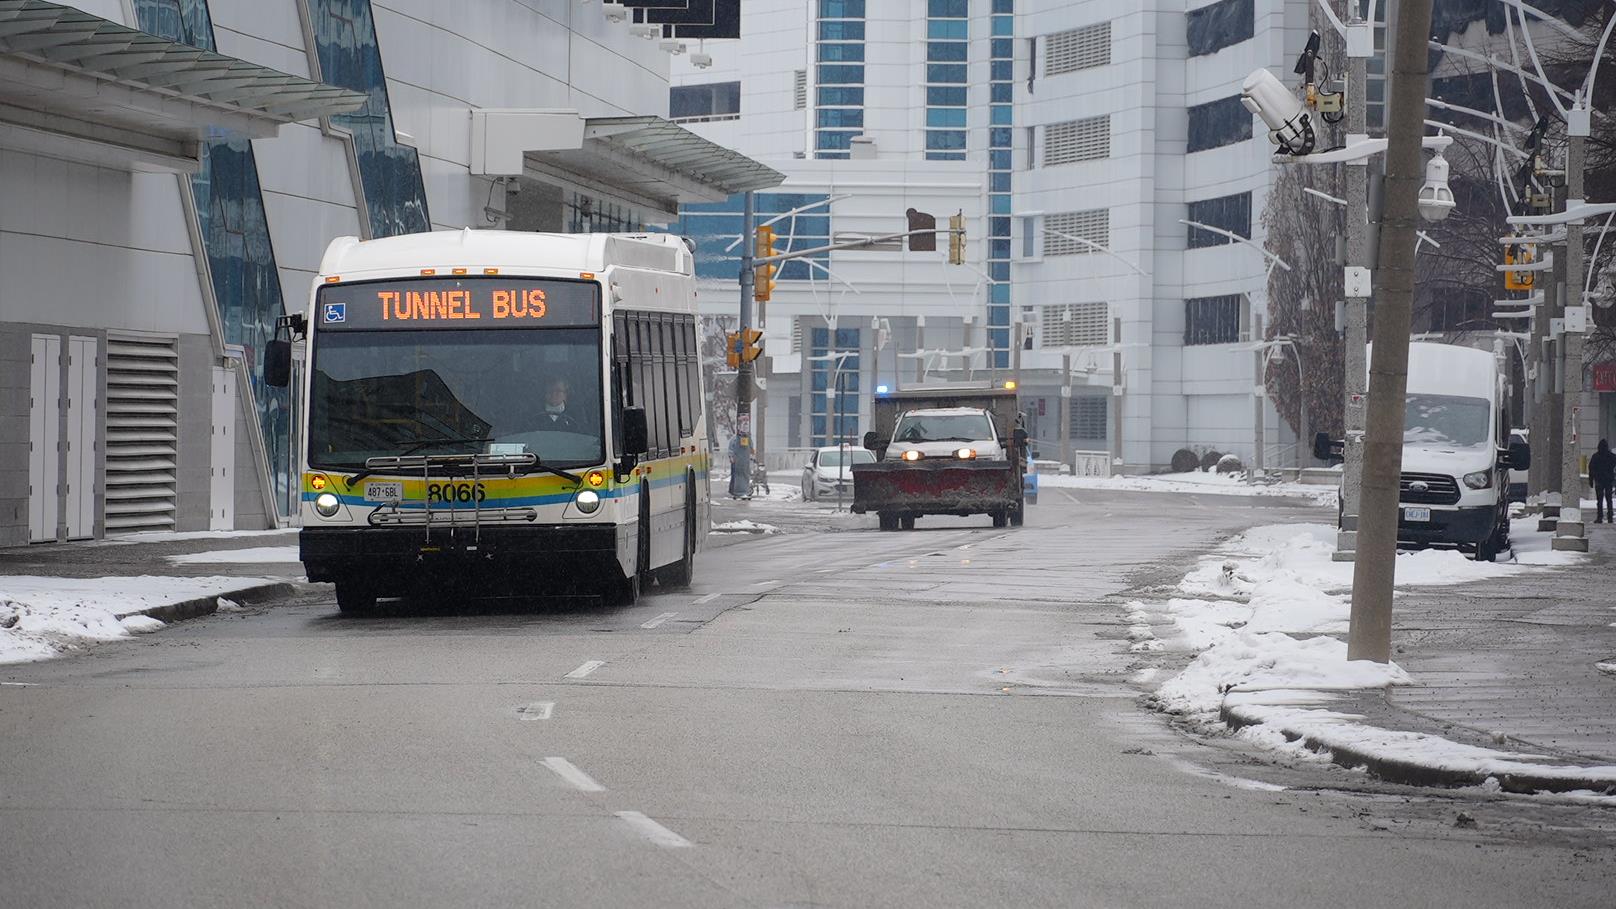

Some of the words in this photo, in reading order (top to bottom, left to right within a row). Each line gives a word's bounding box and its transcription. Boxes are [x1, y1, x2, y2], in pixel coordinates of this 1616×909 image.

[377, 290, 481, 320] TUNNEL
[492, 289, 547, 319] BUS
[428, 483, 486, 503] 8066
